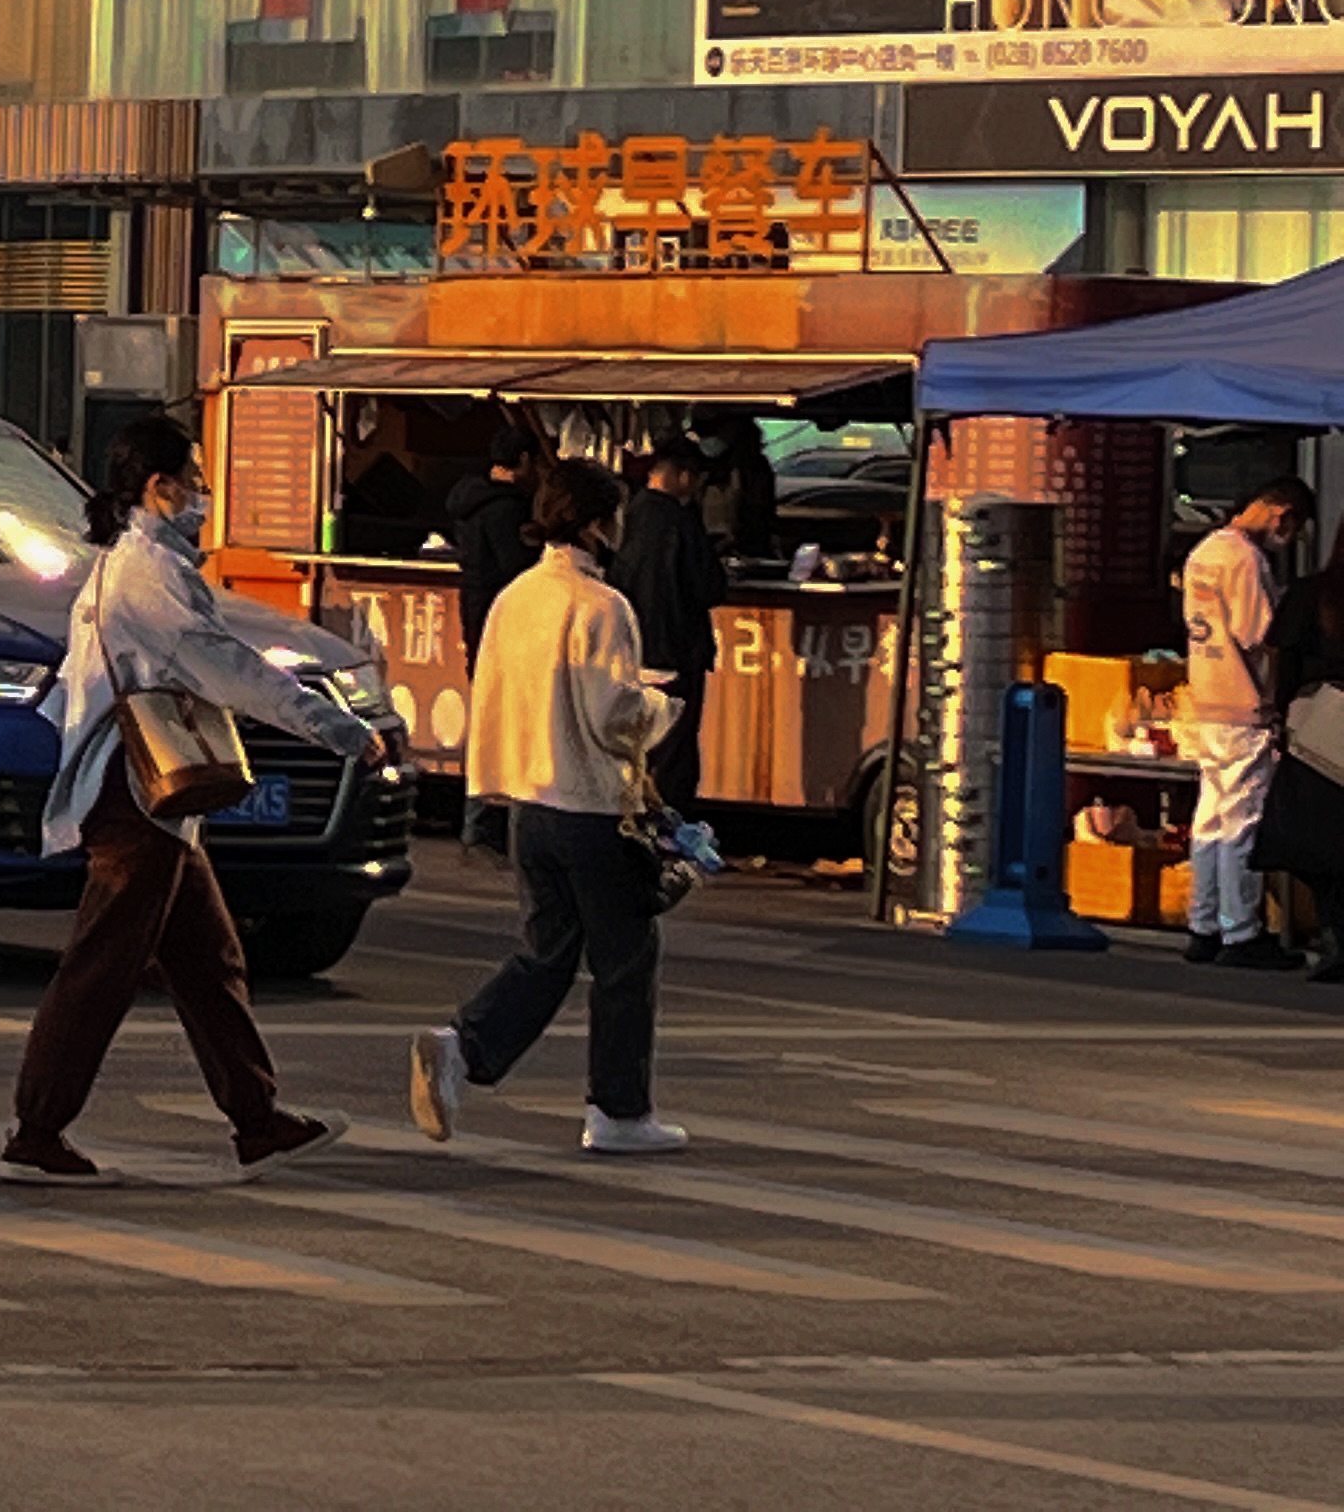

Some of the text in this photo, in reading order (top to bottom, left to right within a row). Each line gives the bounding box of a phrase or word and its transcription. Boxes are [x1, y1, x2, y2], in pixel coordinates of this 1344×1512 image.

[1048, 90, 1324, 153] VOYAH
[440, 125, 864, 271] 环球早餐车
